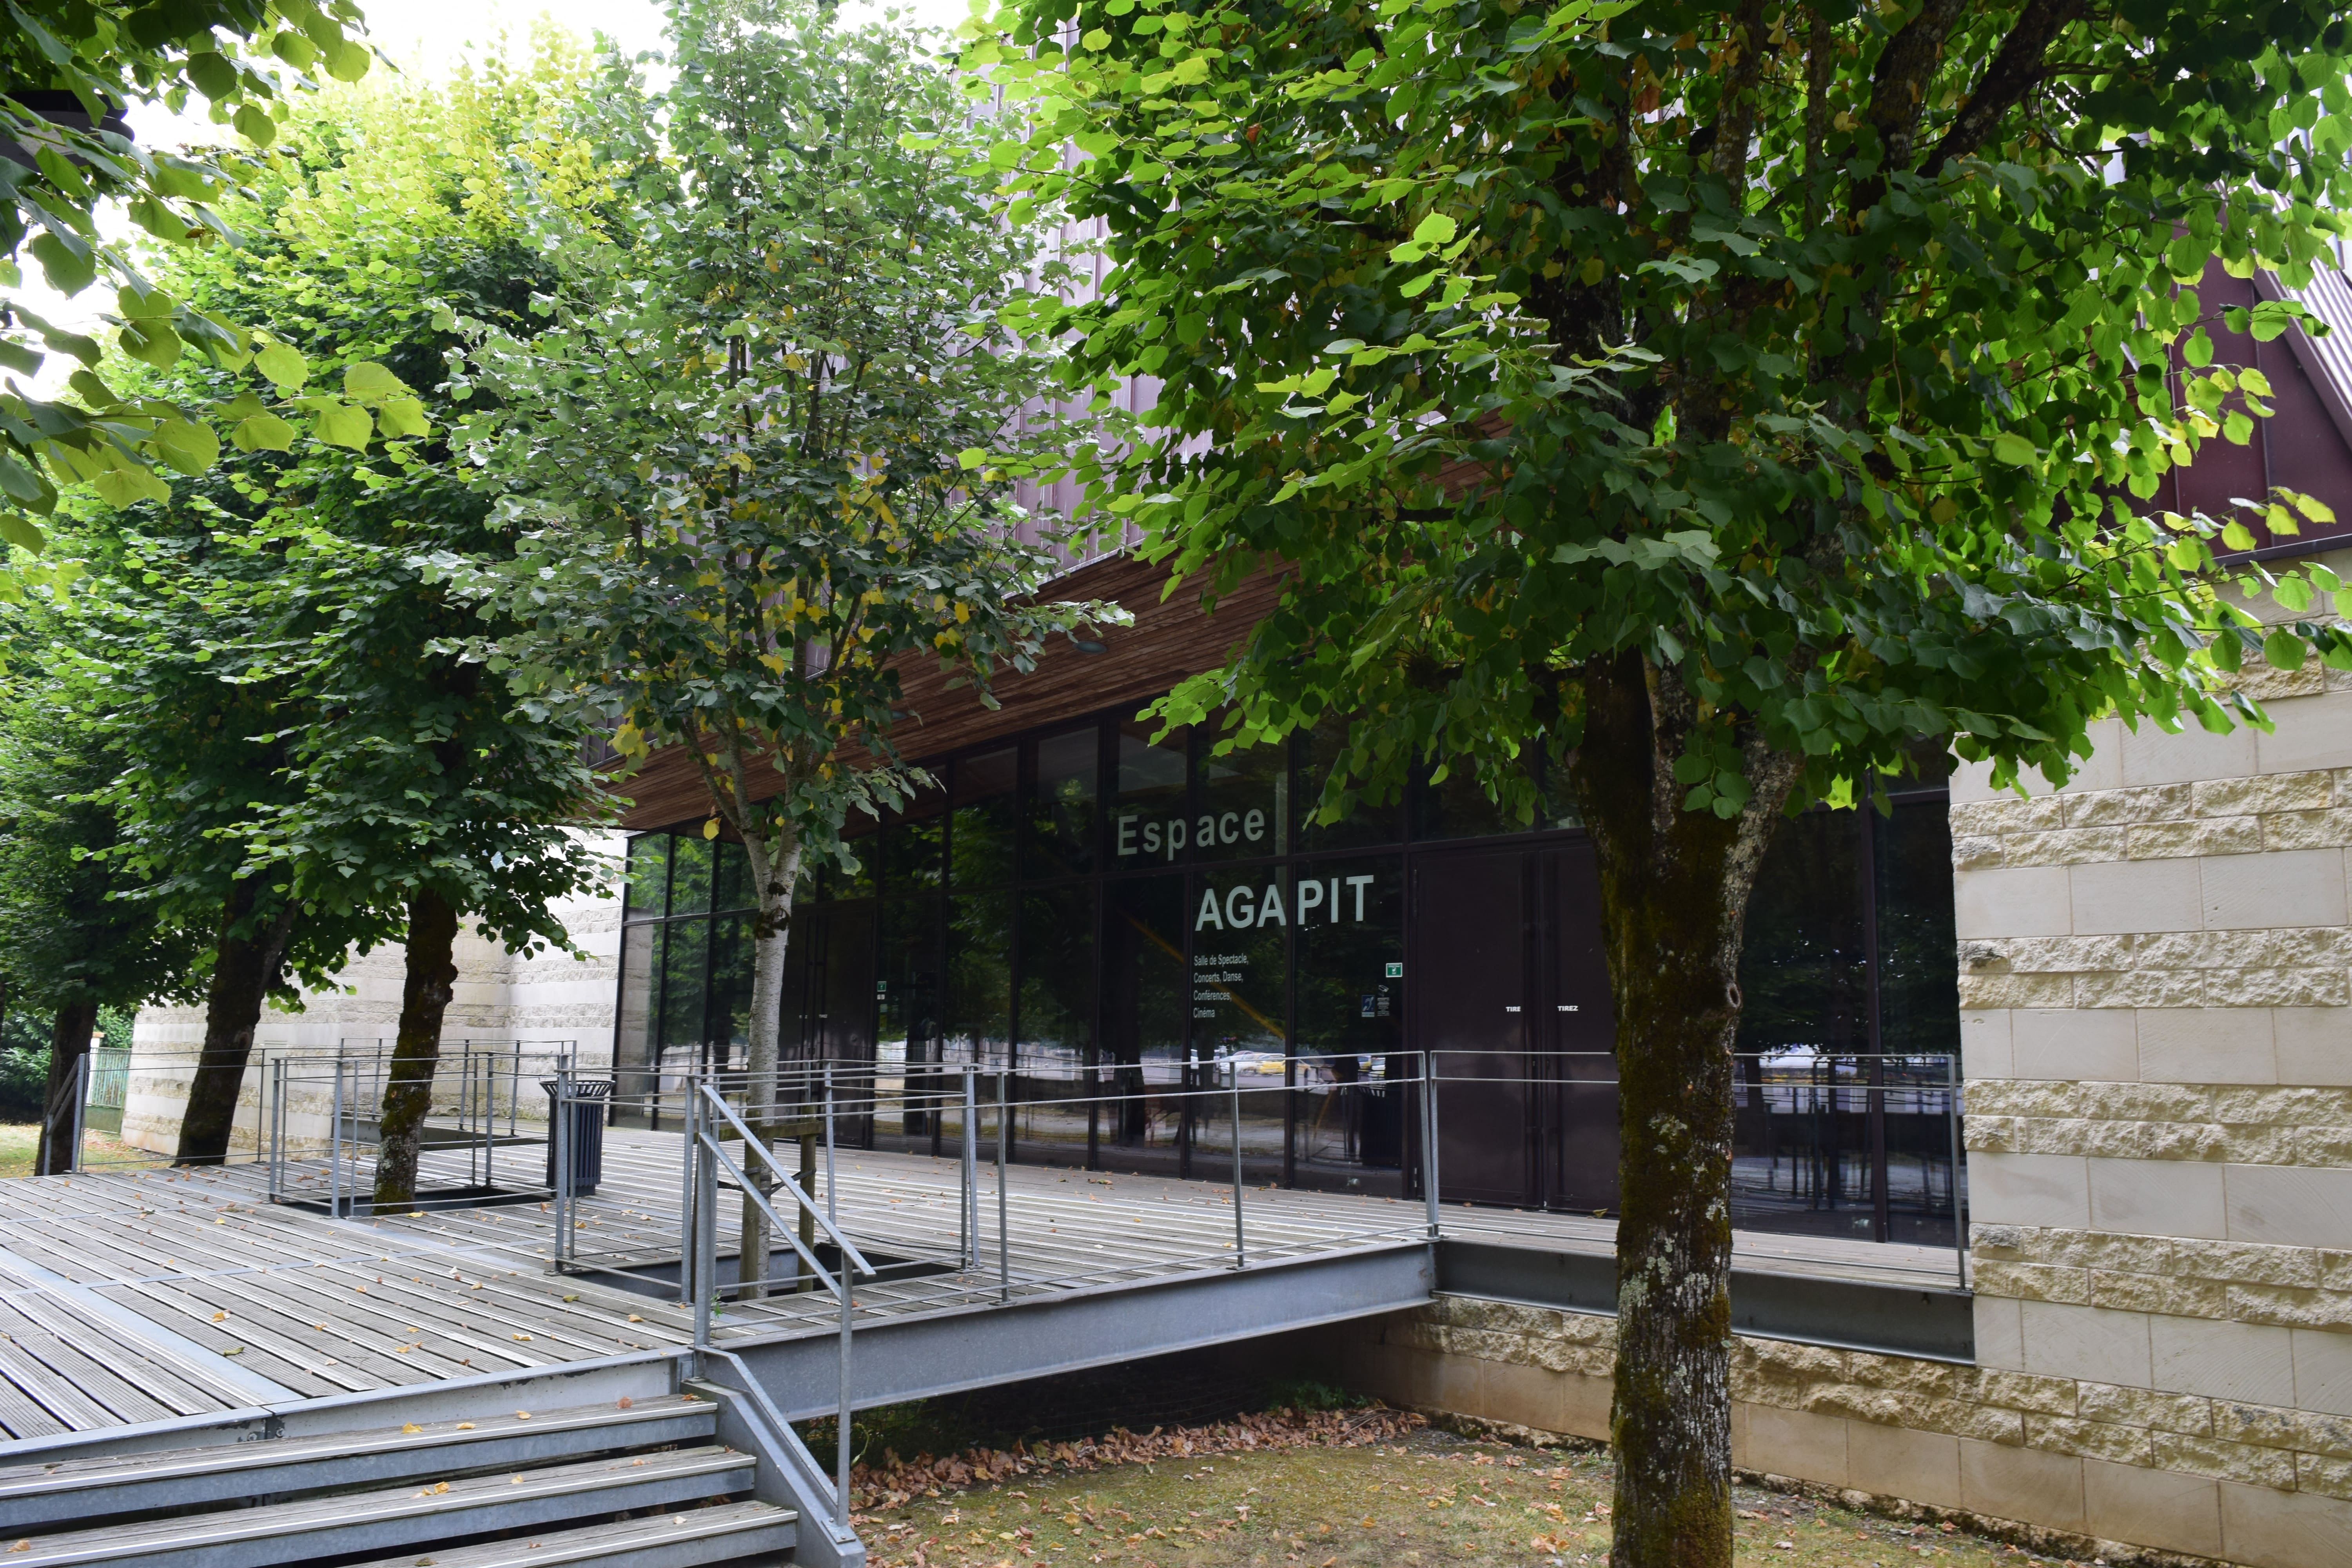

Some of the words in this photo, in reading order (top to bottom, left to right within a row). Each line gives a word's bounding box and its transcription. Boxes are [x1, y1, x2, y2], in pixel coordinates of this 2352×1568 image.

[1118, 809, 1265, 860] Espace
[1195, 875, 1374, 931] AGAPIT
[1194, 955, 1208, 966] Salle
[1209, 955, 1217, 965] de
[1218, 953, 1249, 967] Spectacle,
[1194, 973, 1221, 984] Concerts,
[1223, 971, 1243, 983] Danse,
[1193, 989, 1232, 1002] Conférences,
[1193, 1007, 1215, 1018] Cinéma
